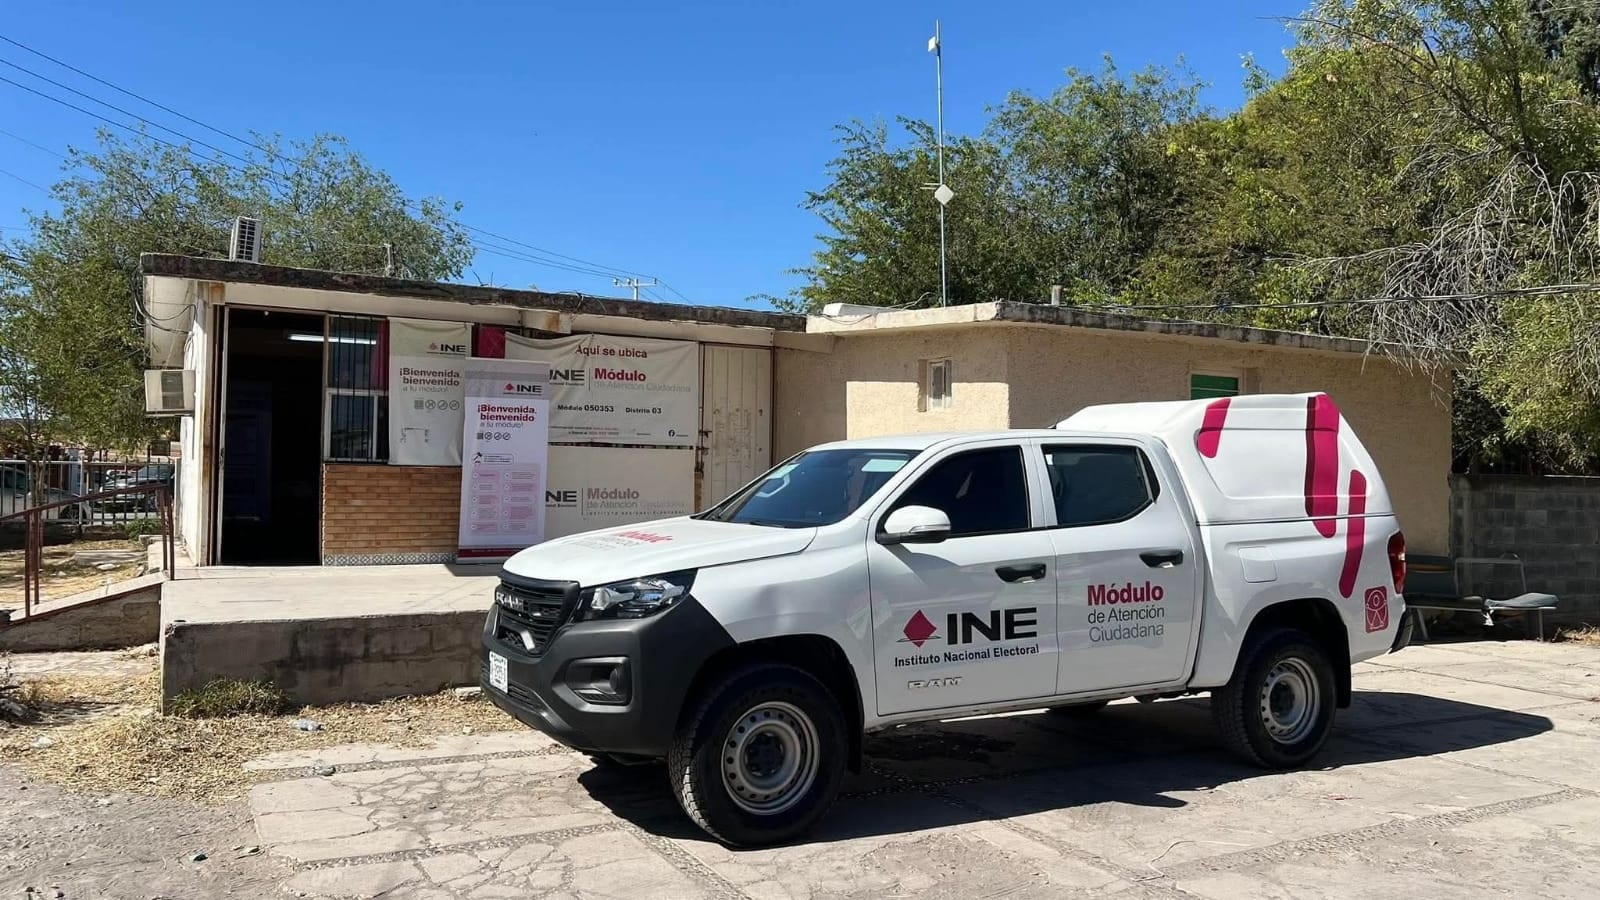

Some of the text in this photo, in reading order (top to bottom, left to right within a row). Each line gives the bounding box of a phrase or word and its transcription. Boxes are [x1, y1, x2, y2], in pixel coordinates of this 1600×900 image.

[440, 344, 467, 352] INE
[576, 345, 648, 359] Aquí se ubica
[402, 376, 460, 386] bienvenido
[594, 367, 647, 382] Módulo
[516, 384, 543, 393] INE
[584, 404, 615, 413] 050353
[480, 412, 535, 422] bienvenido
[545, 490, 577, 502] NE
[587, 487, 640, 500] Módulo
[1087, 580, 1165, 606] Módulo
[1087, 604, 1165, 624] de Atención
[947, 606, 1038, 646] INE
[1088, 623, 1165, 643] Ciudadana
[894, 643, 1040, 667] Instituto Nacional Electoral
[907, 676, 964, 689] RAM
